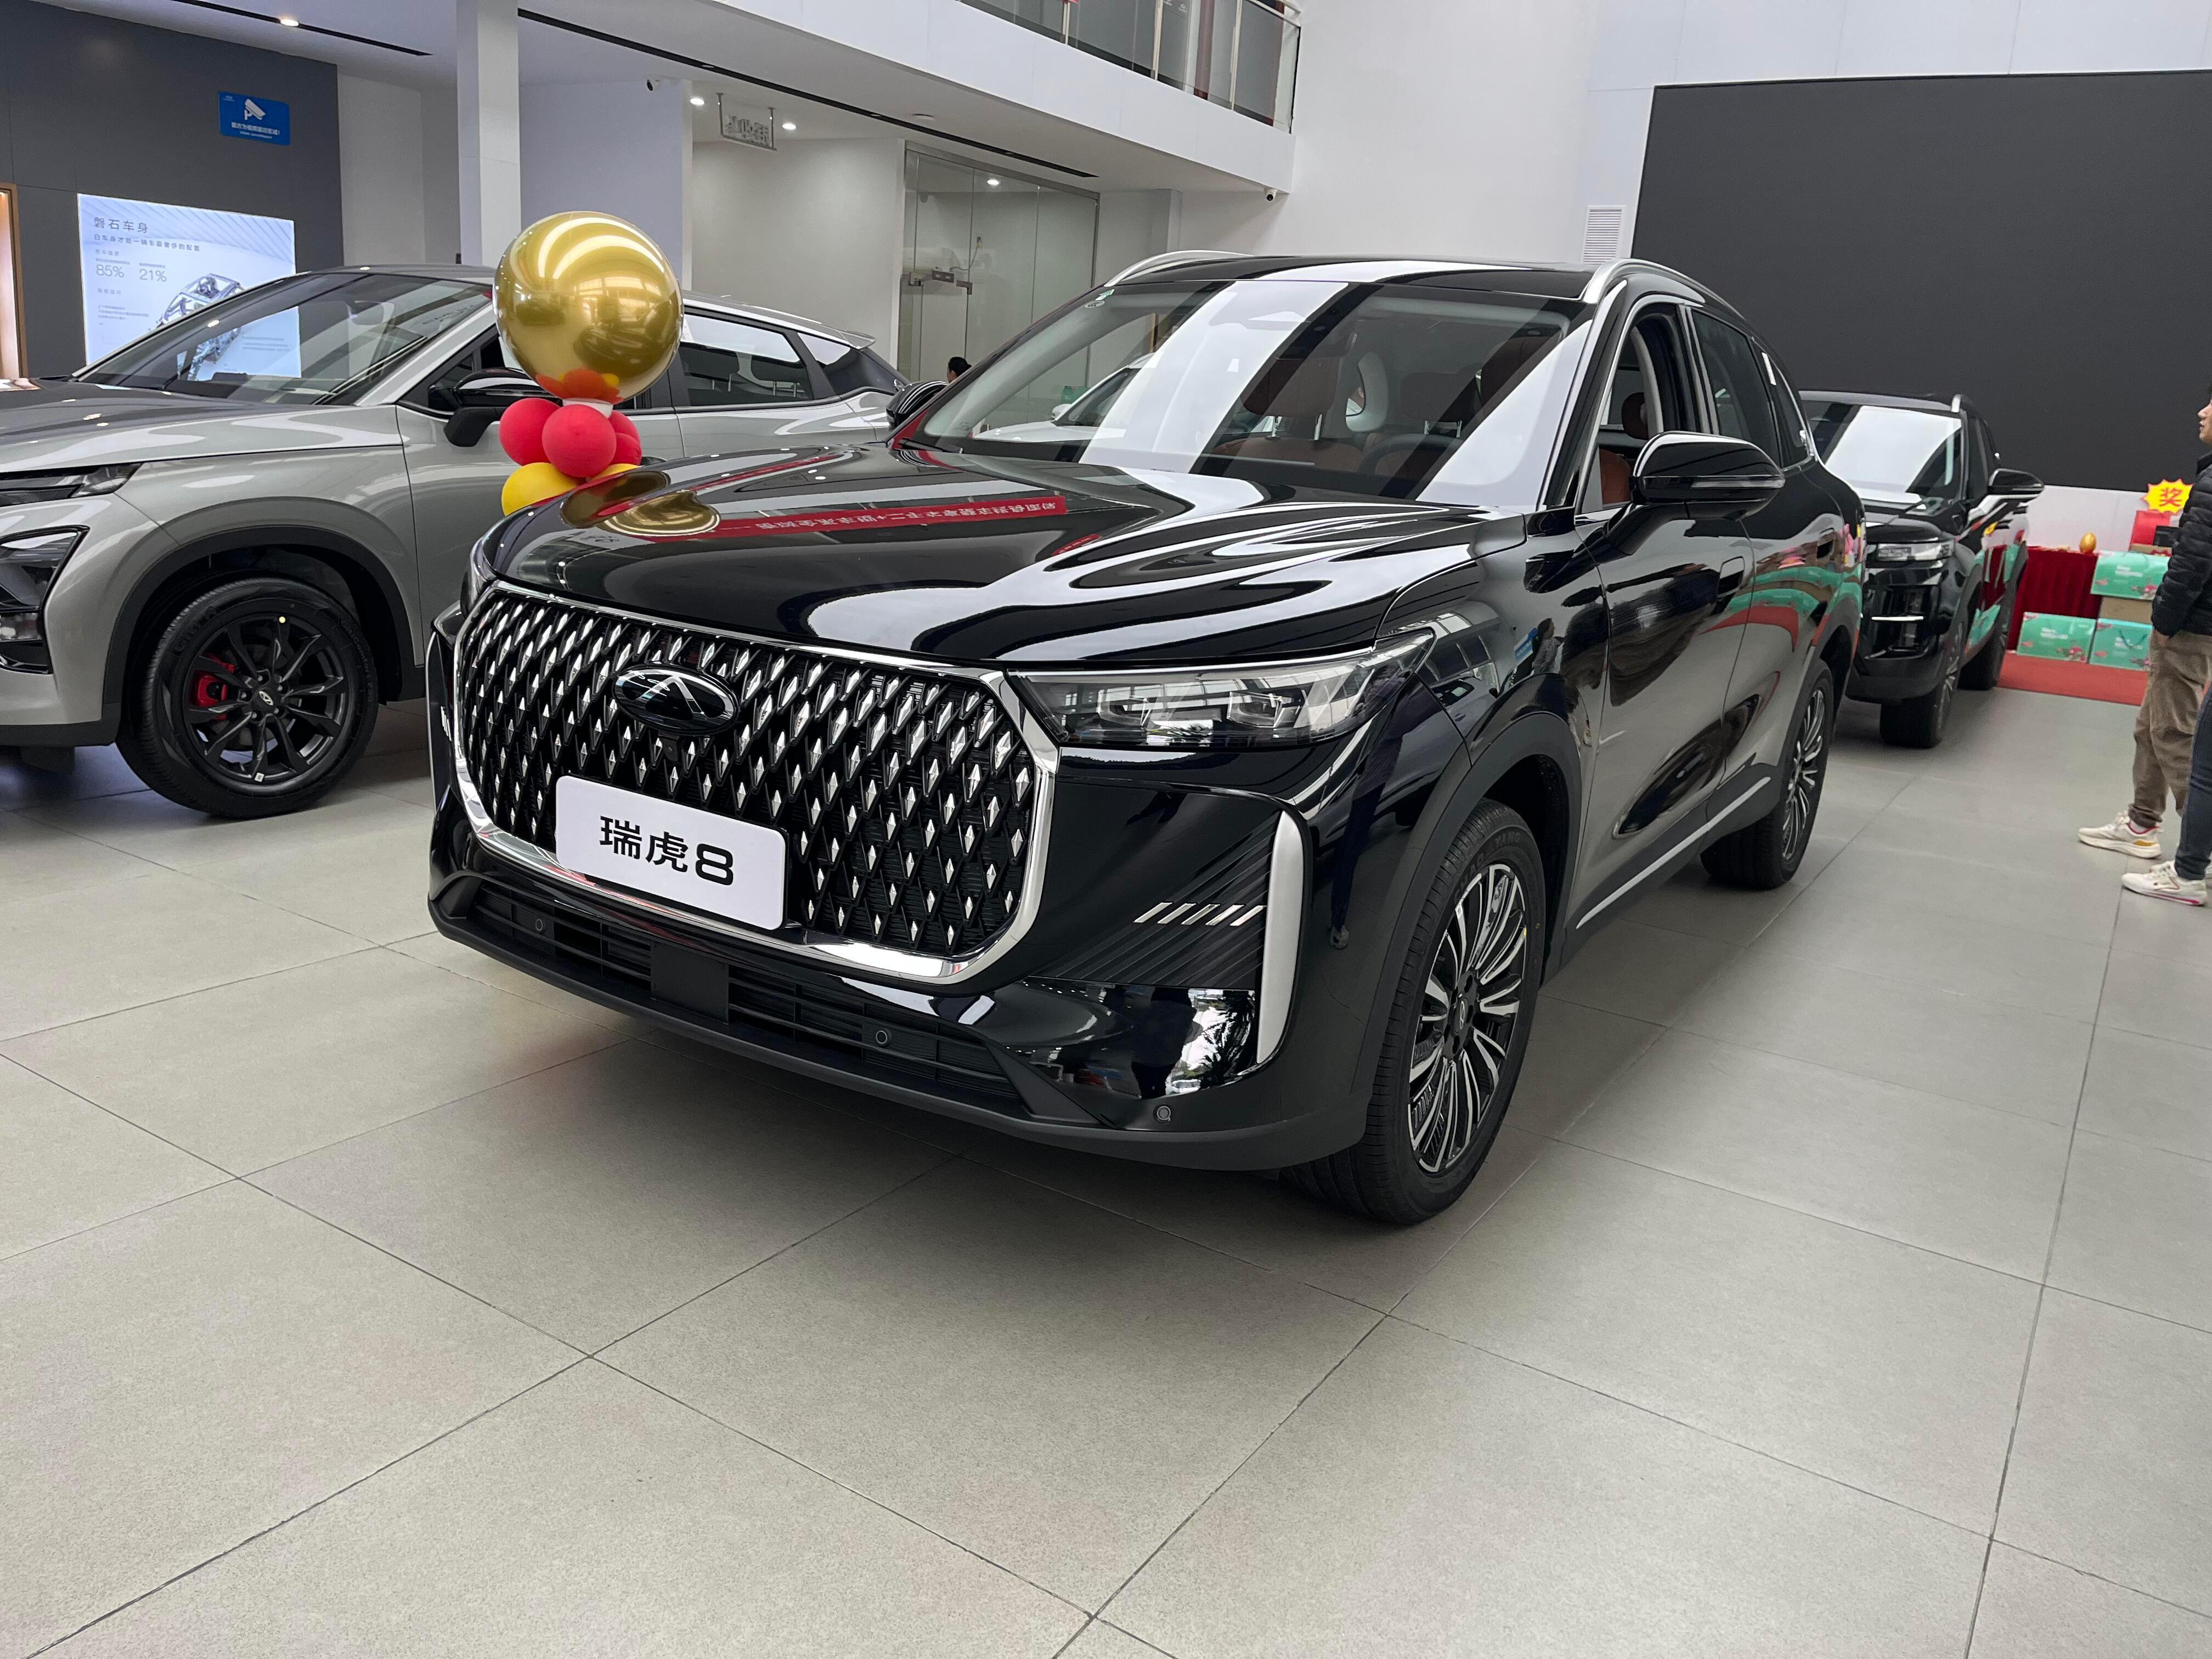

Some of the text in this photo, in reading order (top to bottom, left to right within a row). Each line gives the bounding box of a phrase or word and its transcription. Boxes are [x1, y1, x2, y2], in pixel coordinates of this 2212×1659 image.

[94, 217, 148, 234] 磐石车身
[96, 264, 125, 278] 85%
[139, 268, 167, 282] 21%
[2159, 487, 2183, 507] 奖
[599, 815, 733, 886] 瑞虎8
